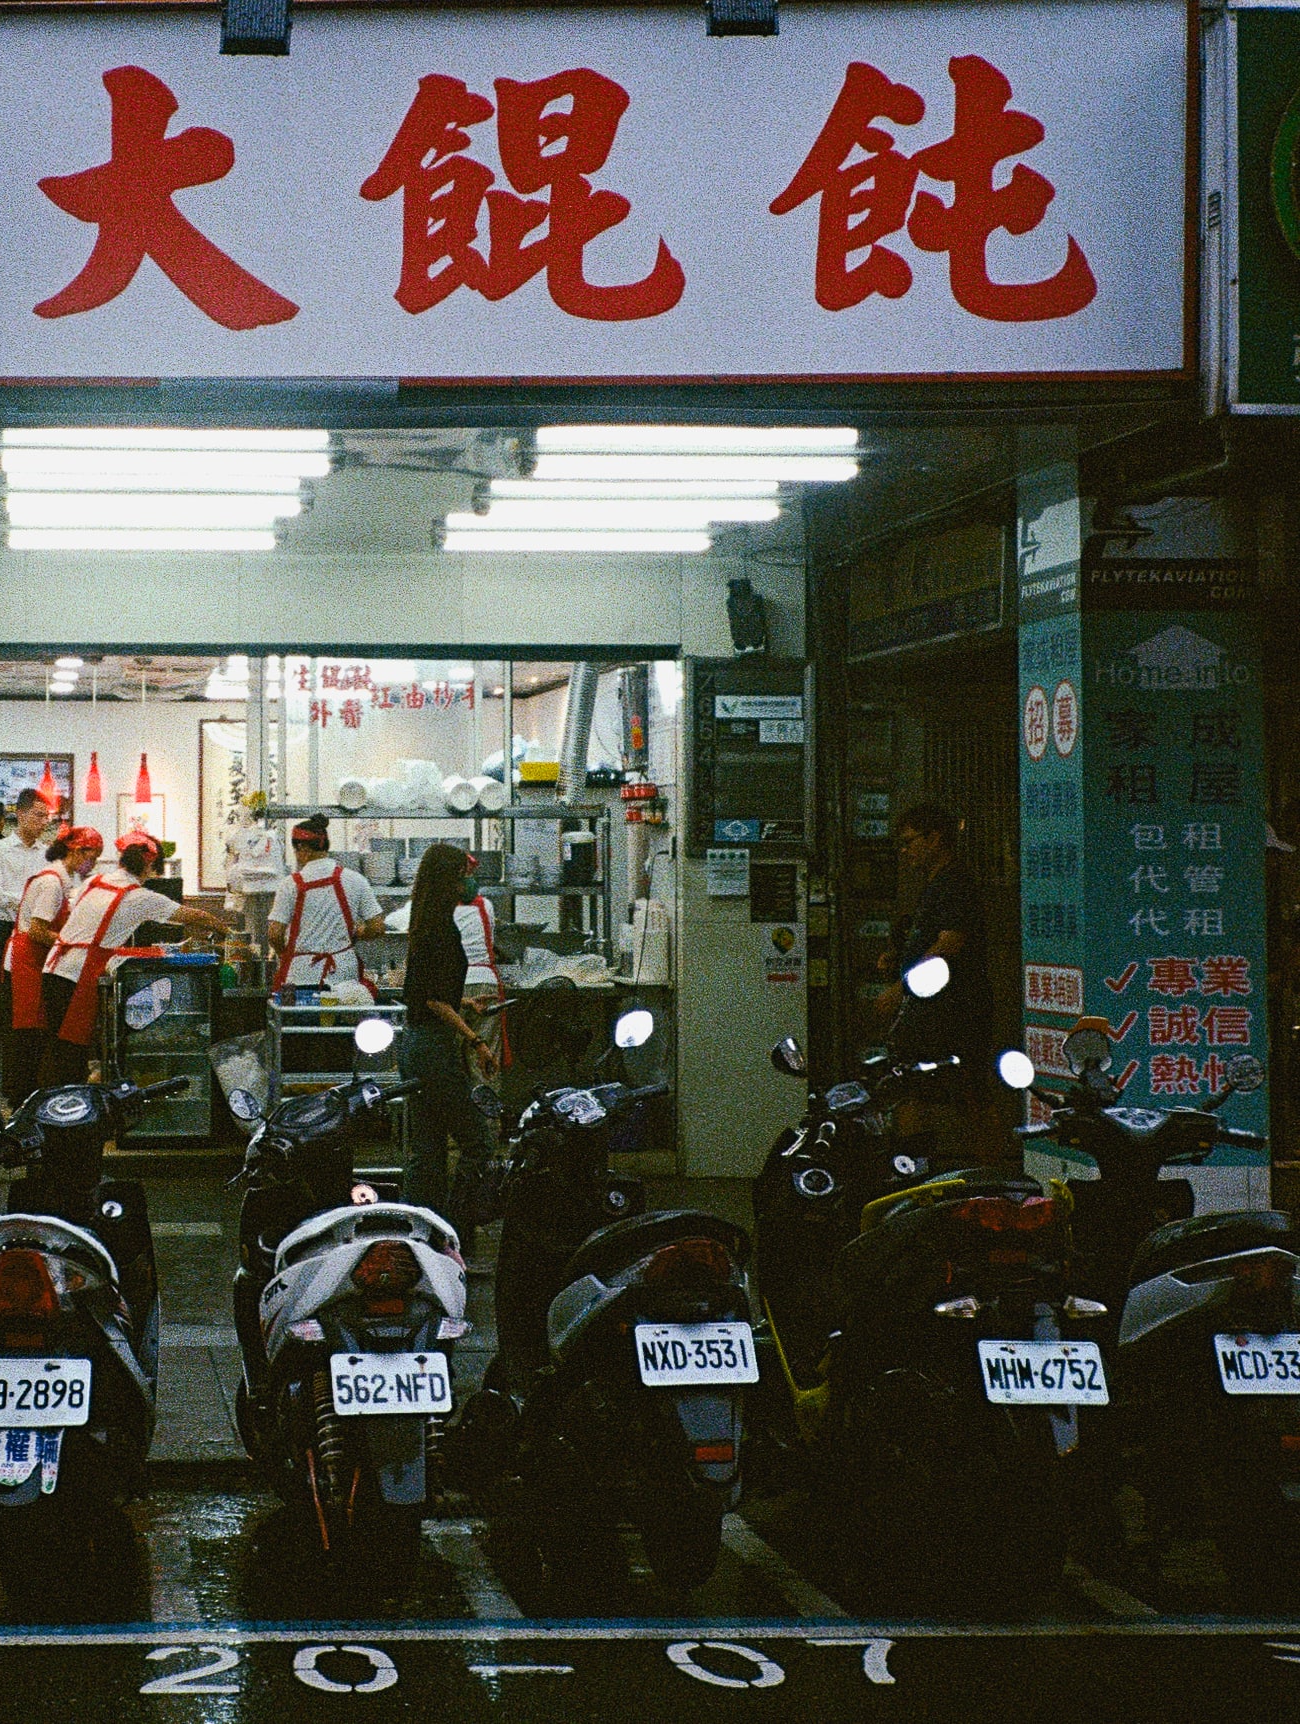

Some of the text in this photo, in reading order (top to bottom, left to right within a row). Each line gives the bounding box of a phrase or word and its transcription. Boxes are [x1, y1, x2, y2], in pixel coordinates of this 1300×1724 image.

[1129, 821, 1223, 851] 包租
[1129, 907, 1225, 937] 代租
[1148, 955, 1252, 997] 專業
[1148, 1006, 1252, 1045] 誠信
[642, 1338, 748, 1371] NXD-3531
[336, 1374, 446, 1405] 562-NFD
[986, 1357, 1102, 1390] MHM-6752
